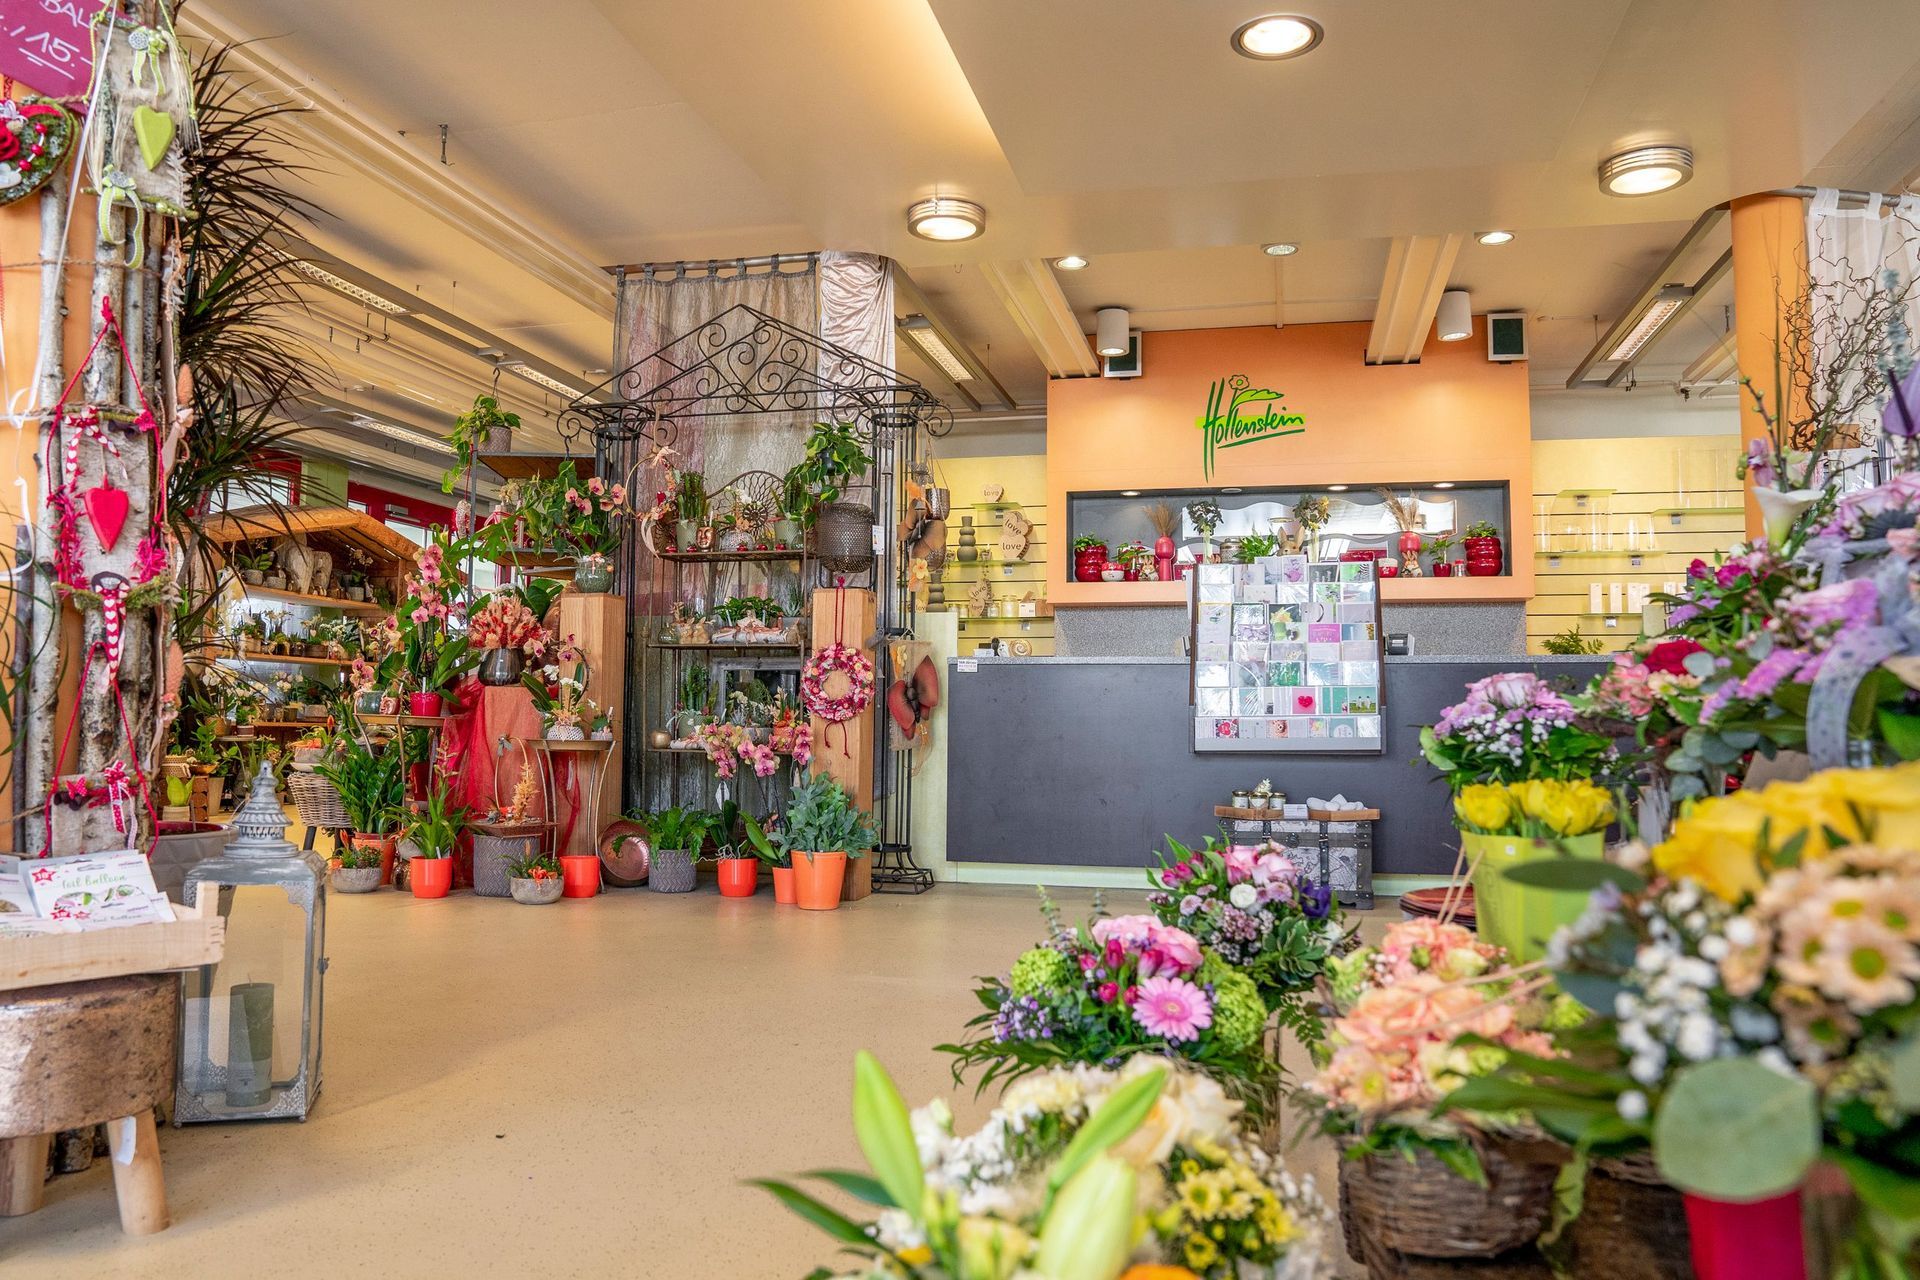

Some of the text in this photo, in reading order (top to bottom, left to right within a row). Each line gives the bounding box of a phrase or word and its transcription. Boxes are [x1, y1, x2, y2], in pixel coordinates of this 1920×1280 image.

[1203, 377, 1304, 484] Hollenstein
[1004, 519, 1022, 536] love
[1002, 542, 1022, 551] love
[971, 585, 987, 598] love
